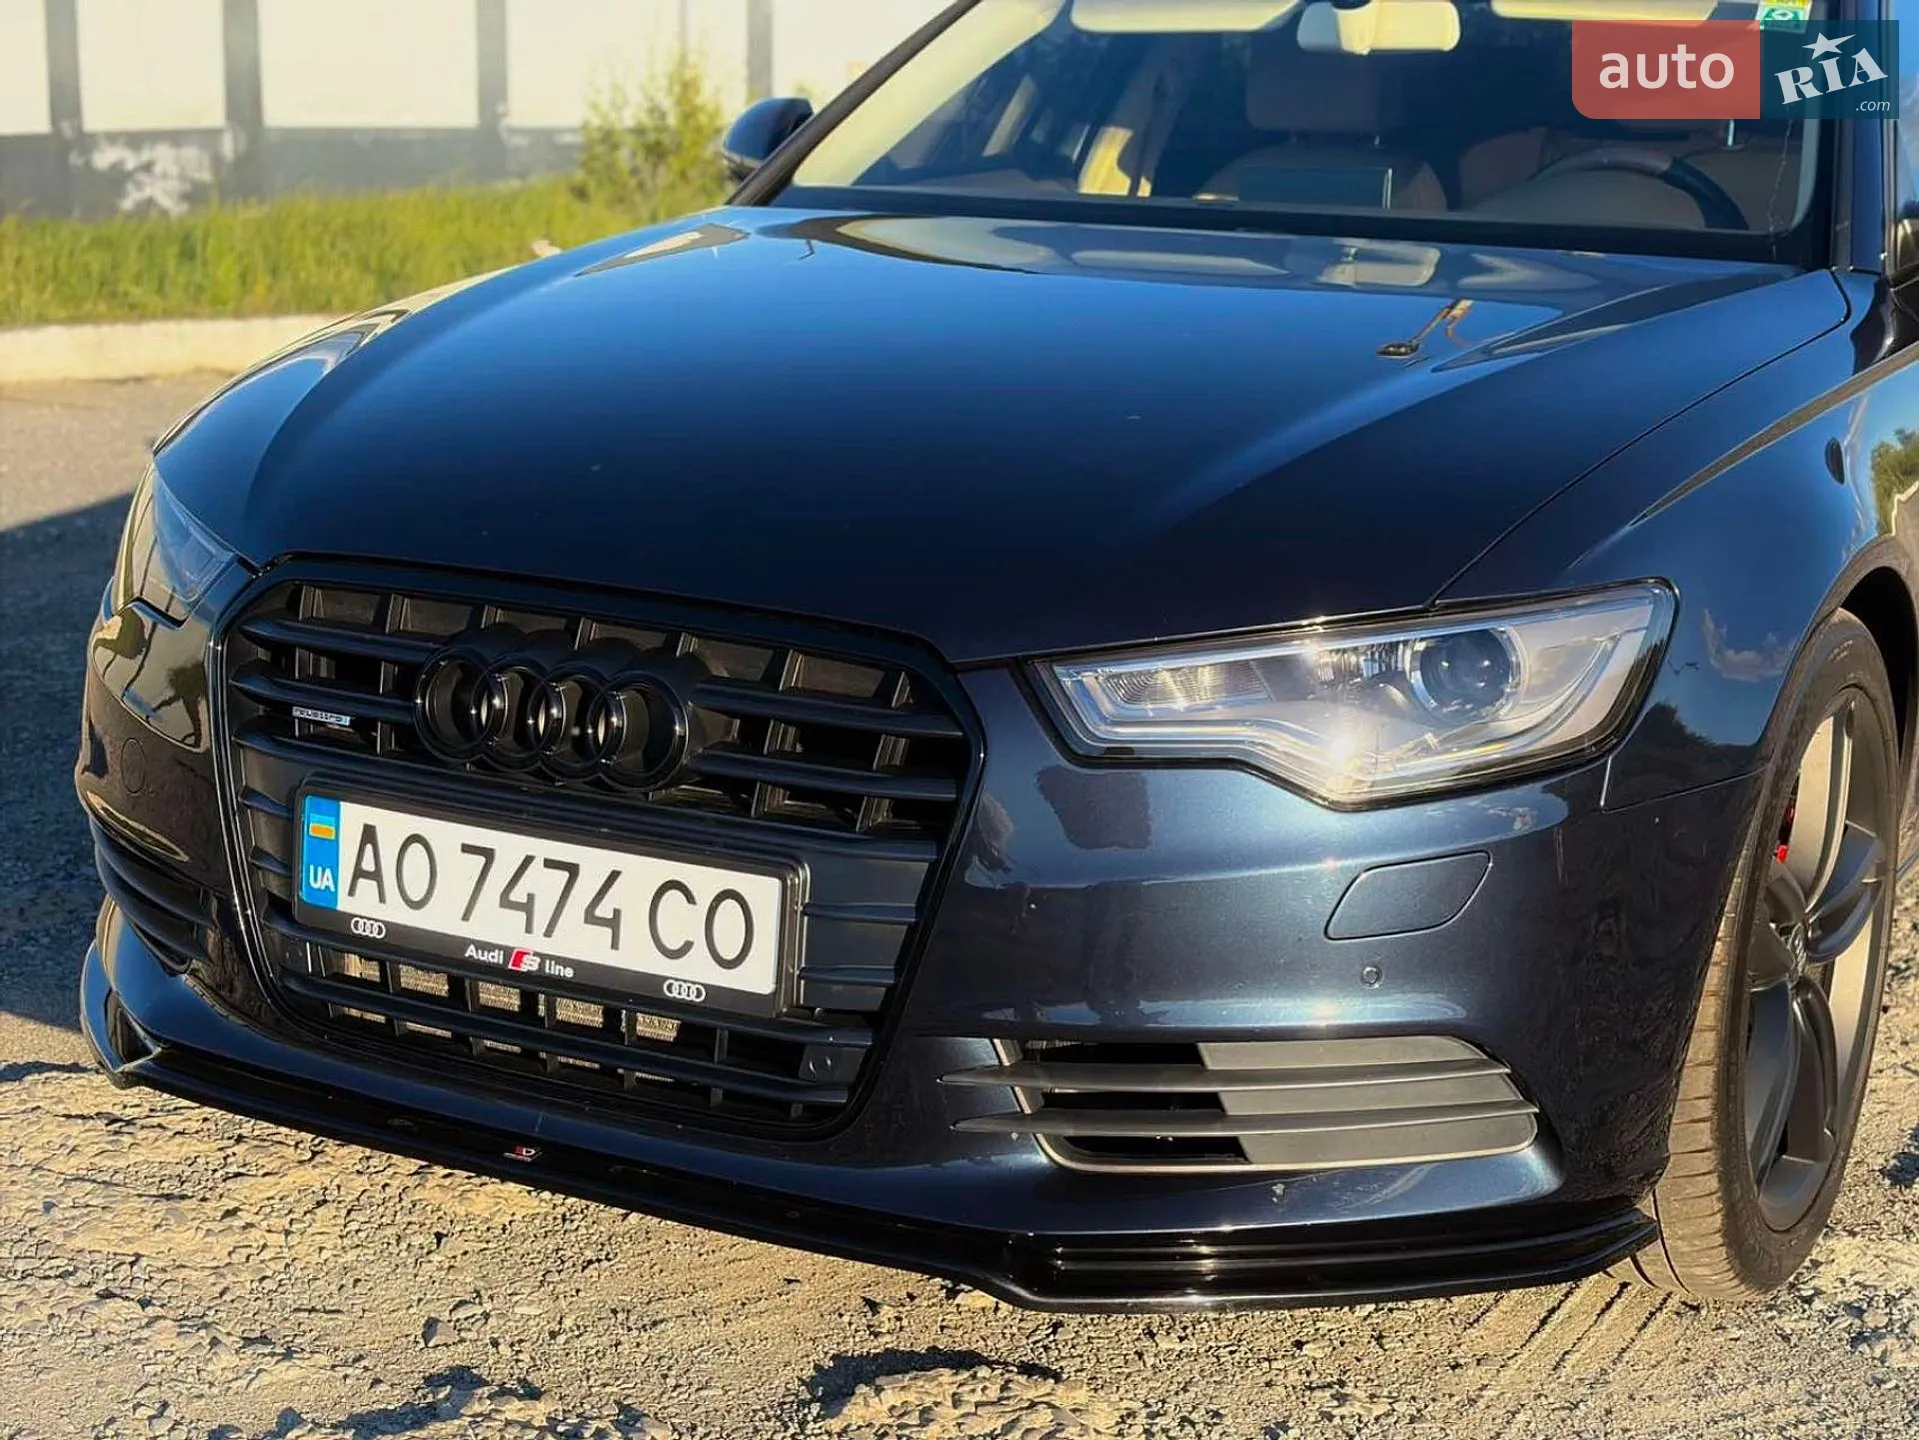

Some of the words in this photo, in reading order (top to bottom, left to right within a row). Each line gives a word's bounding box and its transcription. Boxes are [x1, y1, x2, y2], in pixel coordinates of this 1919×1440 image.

[309, 864, 335, 892] UA
[347, 823, 437, 911] AO
[460, 843, 622, 951] 7474
[648, 879, 754, 970] CO
[465, 944, 504, 964] Audi
[544, 960, 575, 978] line
